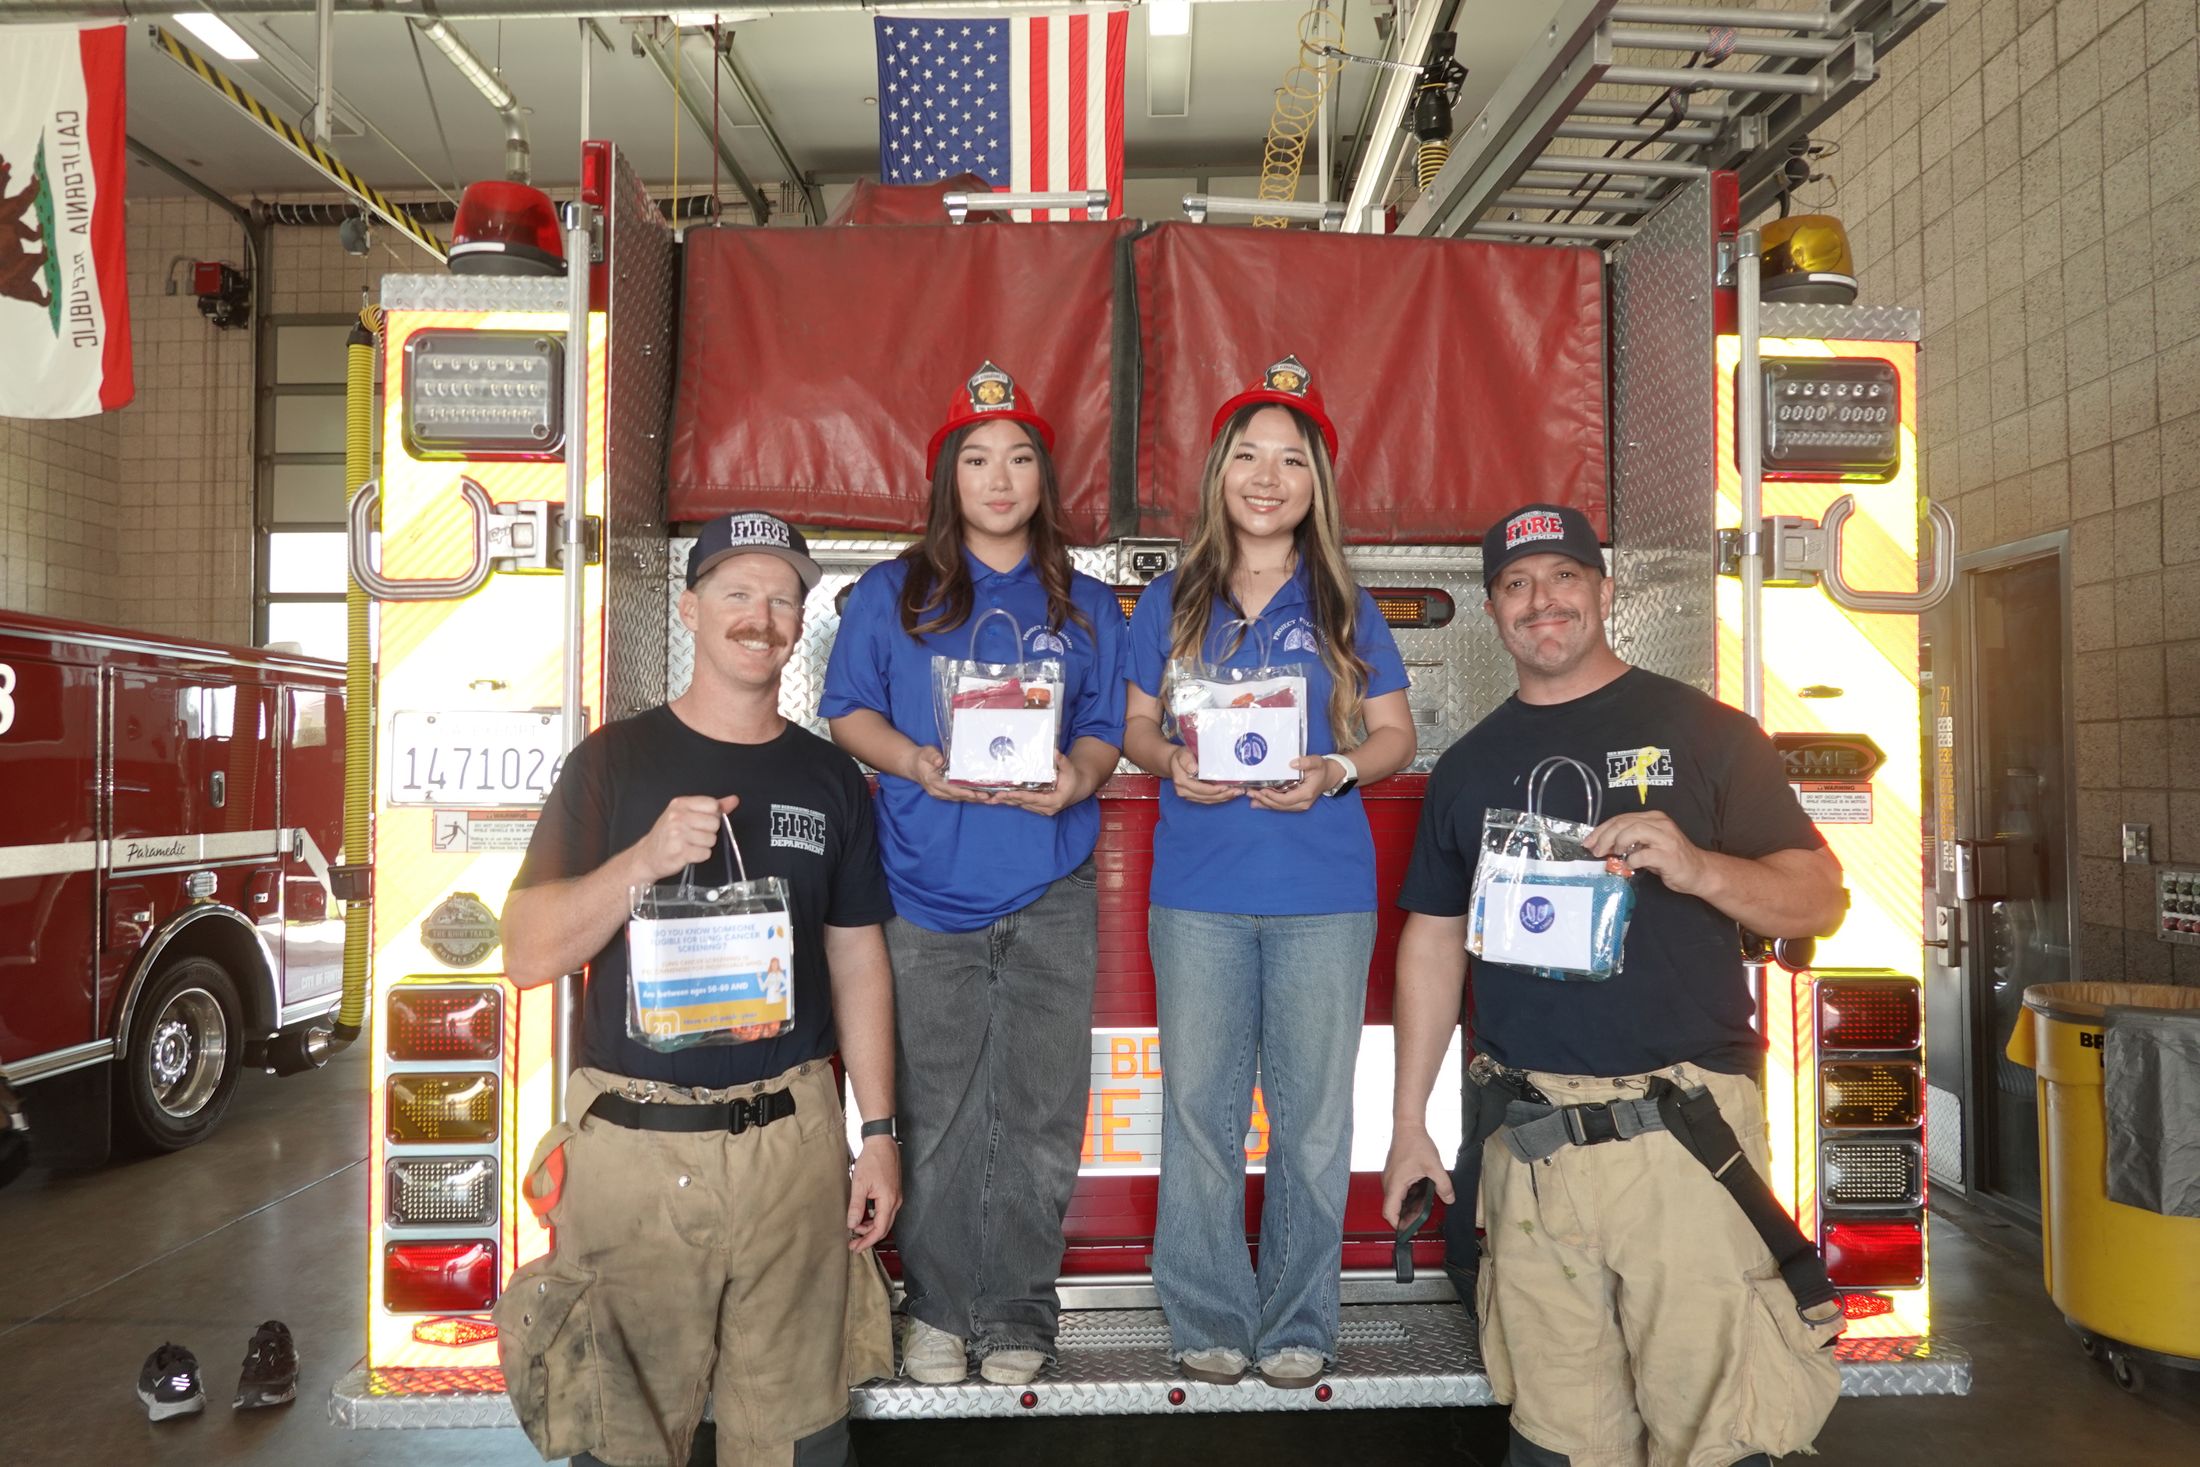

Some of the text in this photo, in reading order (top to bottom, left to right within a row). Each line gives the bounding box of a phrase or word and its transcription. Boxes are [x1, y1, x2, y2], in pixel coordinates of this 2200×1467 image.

[732, 519, 790, 544] FIRE
[1507, 516, 1564, 541] FIRE
[1273, 619, 1297, 641] PROJECT
[1607, 754, 1673, 779] FIE
[1779, 750, 1858, 767] KME
[771, 811, 825, 847] FIRE
[127, 841, 186, 862] Paramedic
[771, 839, 824, 855] DEPARTMENT
[668, 928, 684, 936] YOU
[685, 927, 710, 935] KNOW
[712, 924, 756, 933] SOMEONE
[683, 936, 697, 944] FOR
[724, 931, 760, 941] CANCER
[730, 982, 749, 991] AND
[2080, 1032, 2104, 1049] BR
[1111, 1037, 1162, 1079] BD
